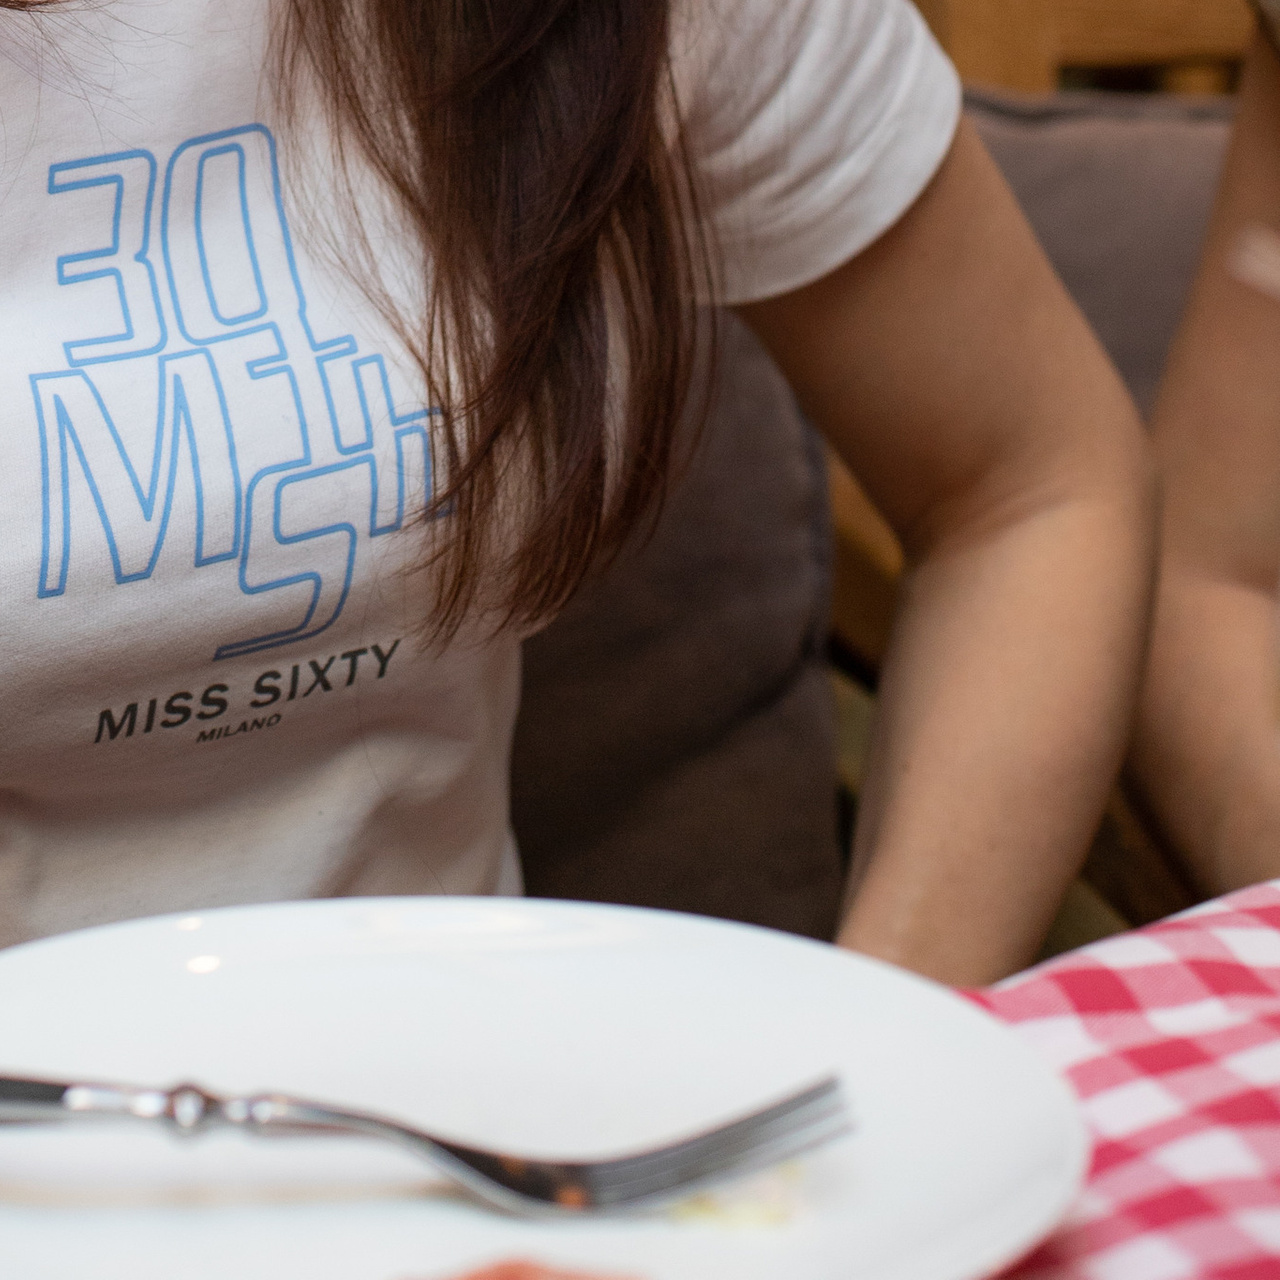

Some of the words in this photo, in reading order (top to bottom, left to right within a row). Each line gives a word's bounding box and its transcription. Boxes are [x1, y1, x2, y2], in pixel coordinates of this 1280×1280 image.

[93, 683, 230, 744] MISS
[250, 639, 402, 708] SIXTY
[196, 712, 282, 744] MILANO
